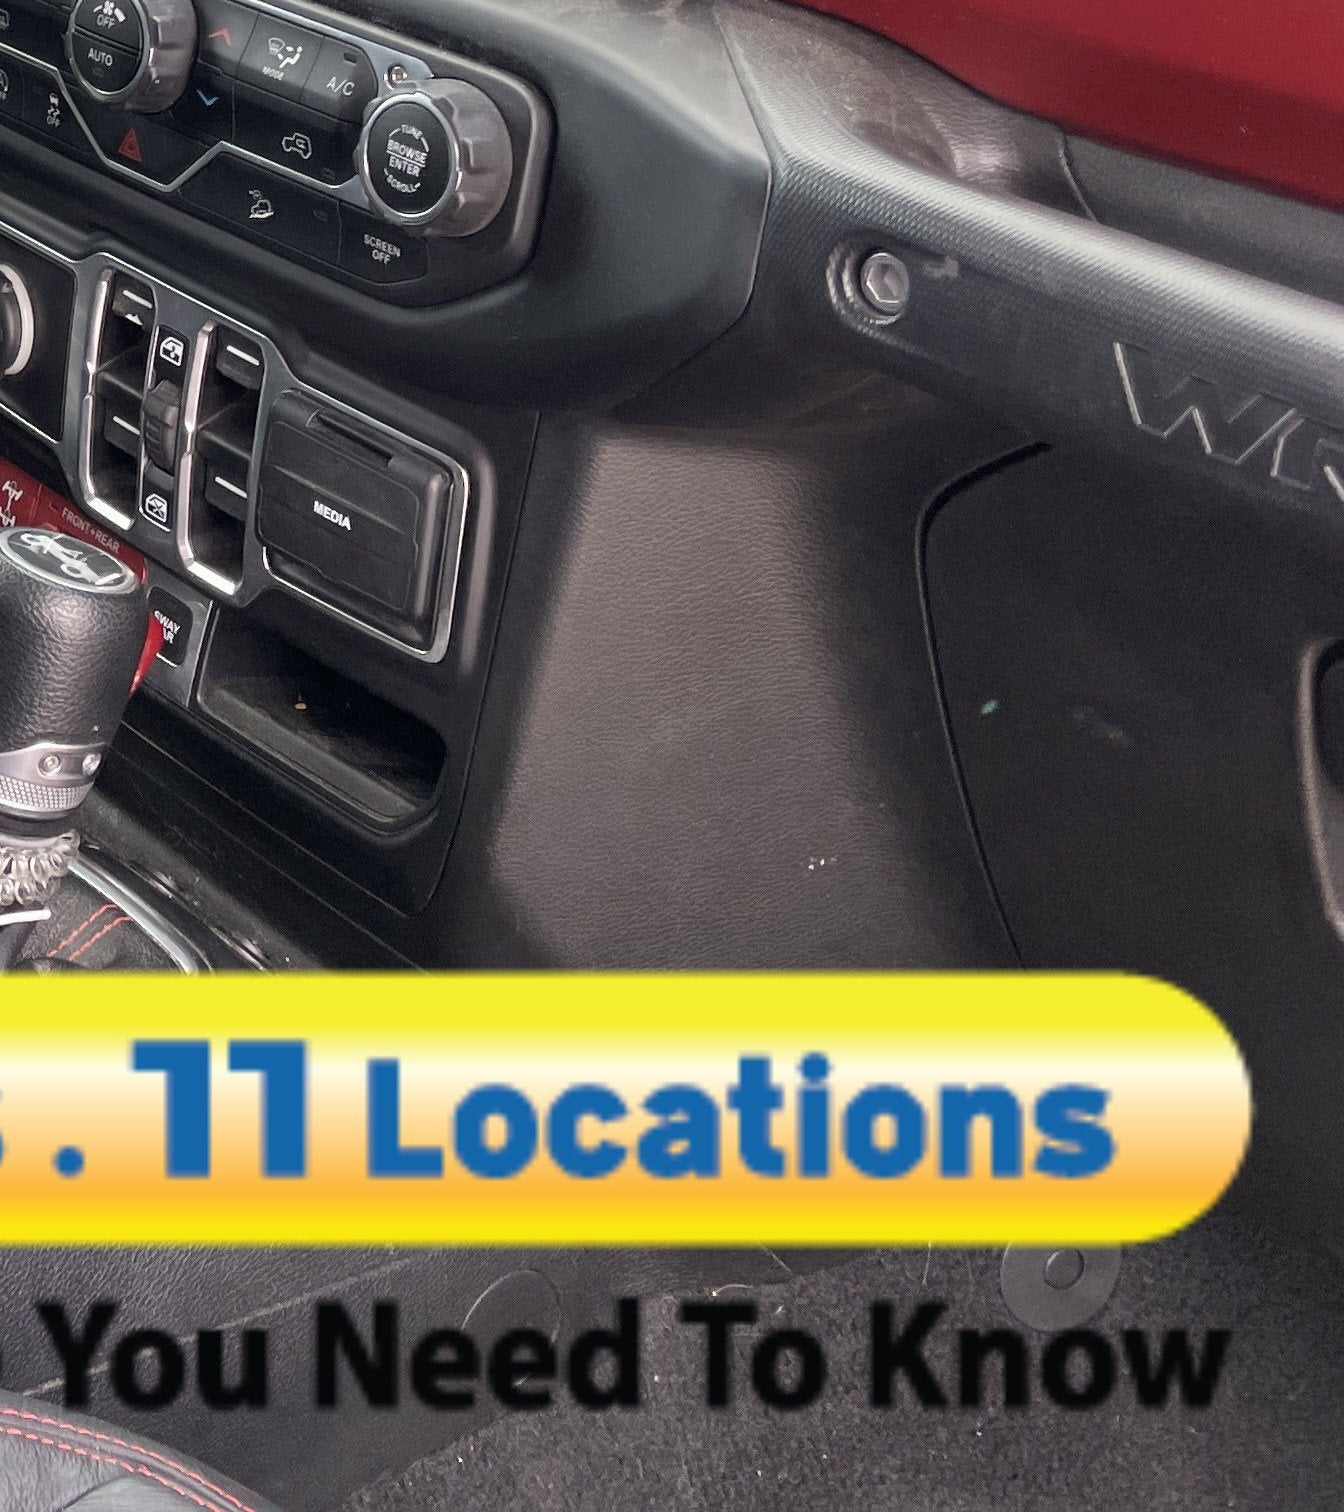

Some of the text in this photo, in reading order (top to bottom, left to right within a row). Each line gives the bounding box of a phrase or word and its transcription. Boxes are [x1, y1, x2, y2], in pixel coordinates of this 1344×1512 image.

[96, 14, 115, 29] OFF
[88, 47, 113, 67] AUTO
[262, 65, 286, 81] MODE
[326, 76, 355, 96] A/C
[401, 124, 423, 139] TUNE
[387, 139, 428, 165] BROWSE
[389, 157, 420, 177] ENTER
[386, 174, 417, 193] SCROLL
[364, 234, 401, 258] SCREEN
[372, 249, 391, 265] OFF
[314, 500, 351, 531] MEDIA
